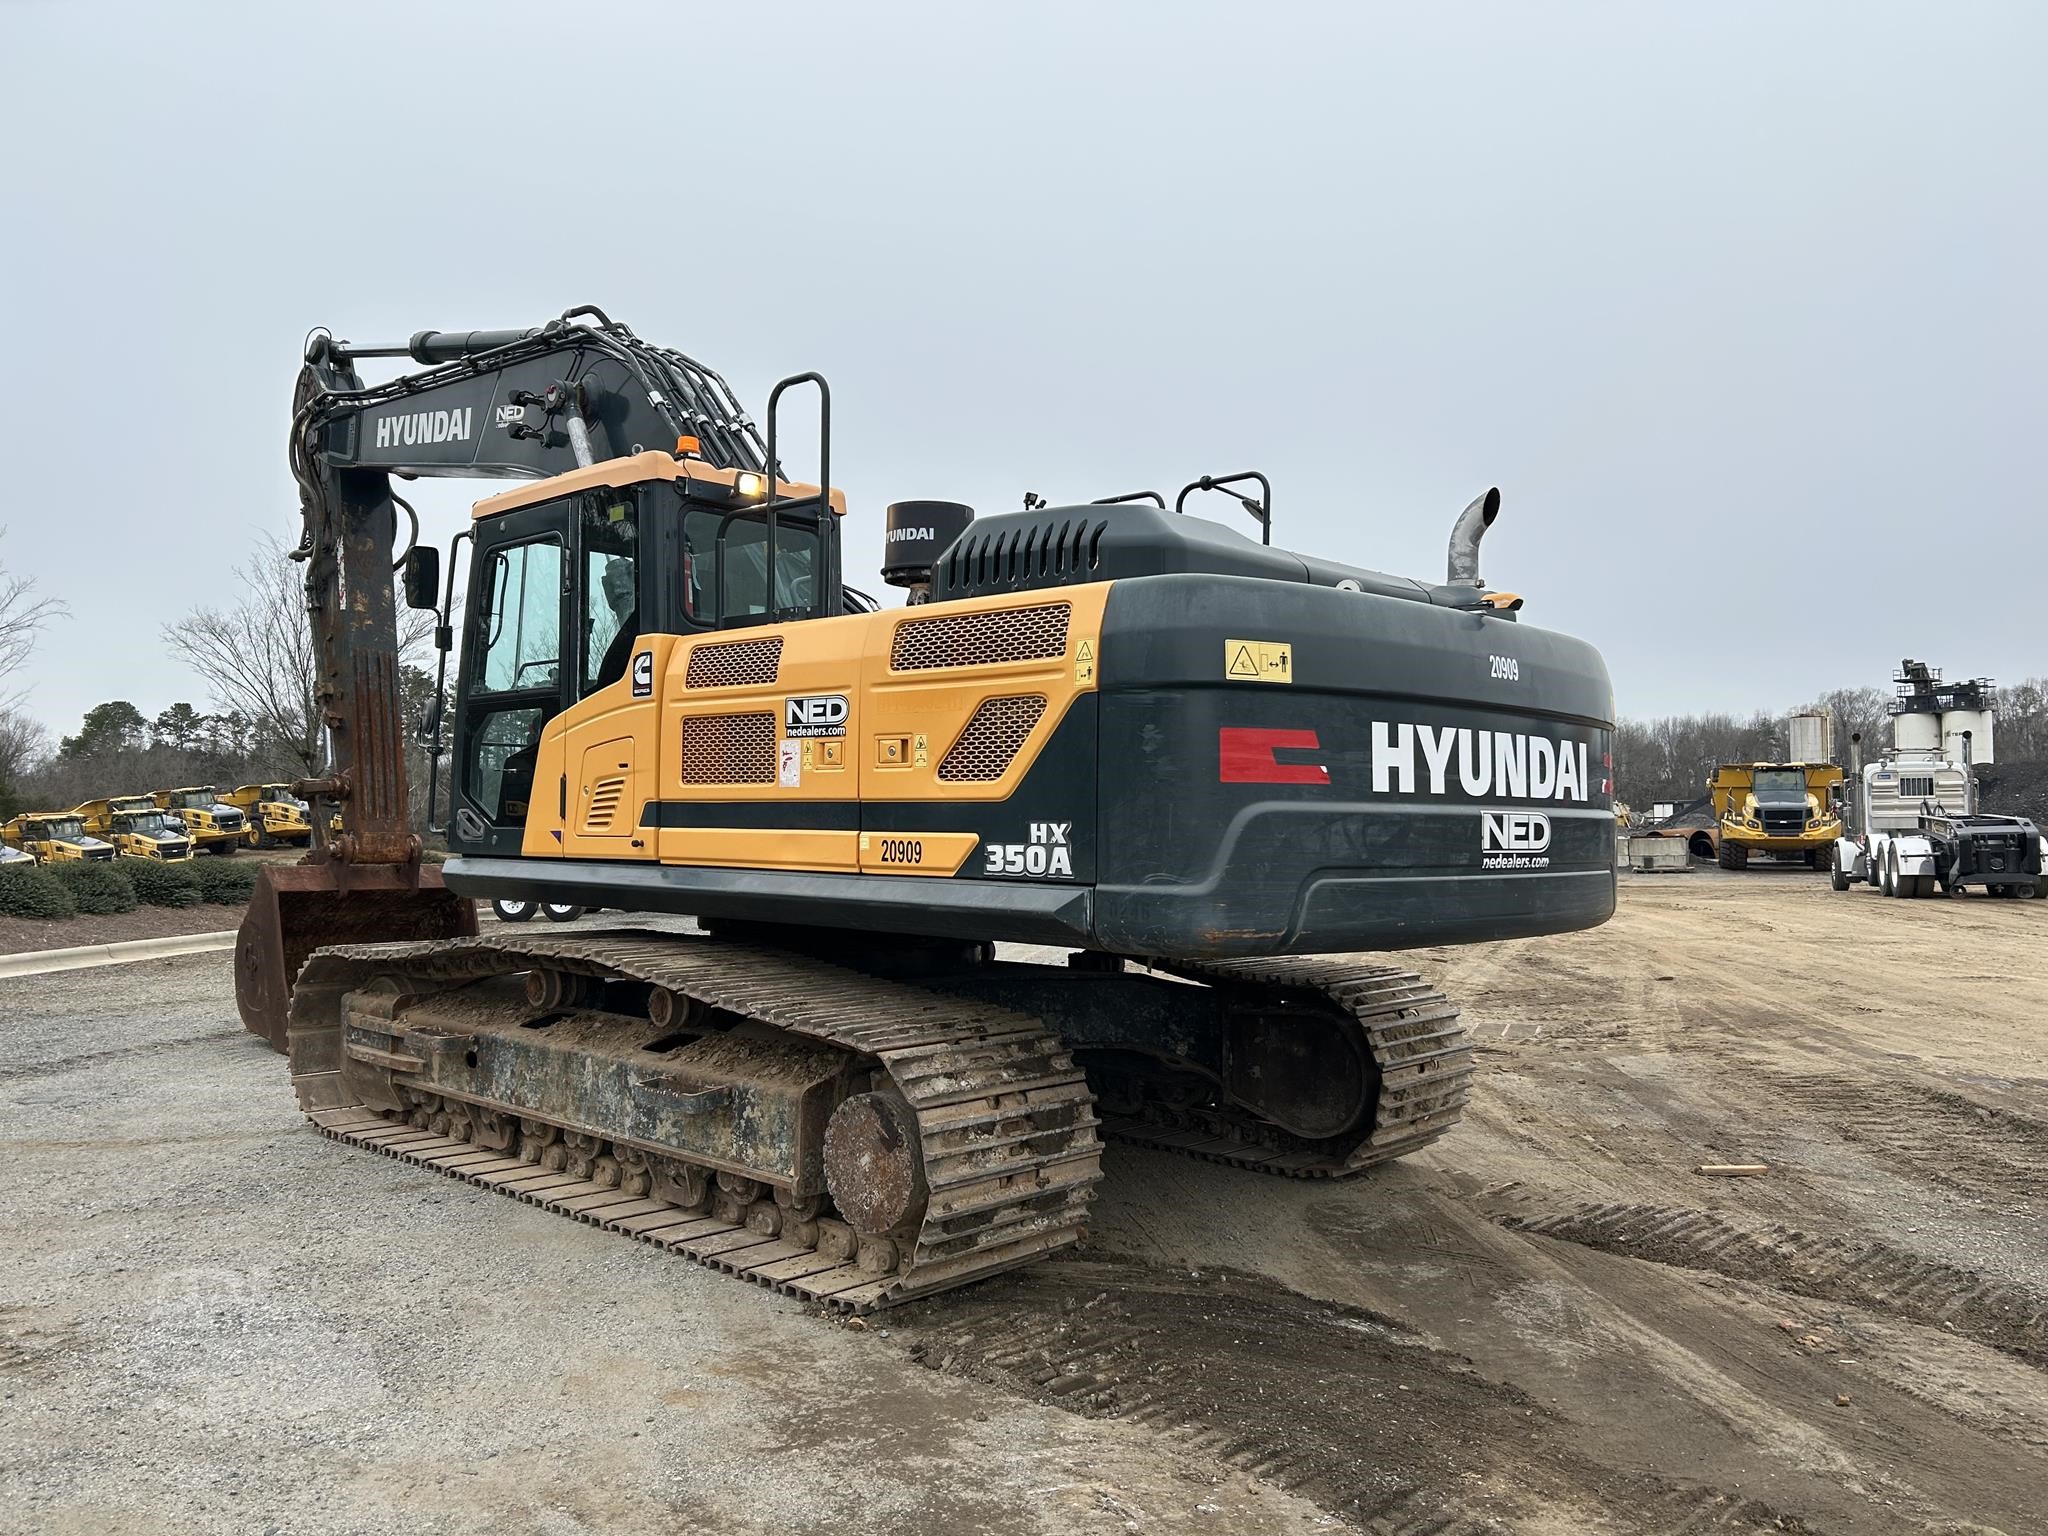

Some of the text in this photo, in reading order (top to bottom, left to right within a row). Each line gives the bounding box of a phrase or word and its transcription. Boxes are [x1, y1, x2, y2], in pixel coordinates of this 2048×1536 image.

[495, 405, 525, 421] NED
[376, 407, 472, 448] HYUNDAI
[886, 527, 934, 544] YUNDAI
[1489, 654, 1519, 681] 20909
[787, 698, 848, 724] NED
[787, 726, 845, 737] nedealers.com
[1371, 721, 1588, 801] HYUNDAI
[1030, 823, 1068, 844] HX
[1482, 813, 1550, 850] NED
[881, 839, 922, 864] 20909
[985, 845, 1073, 876] 350A
[1481, 853, 1550, 869] nedealers.com
